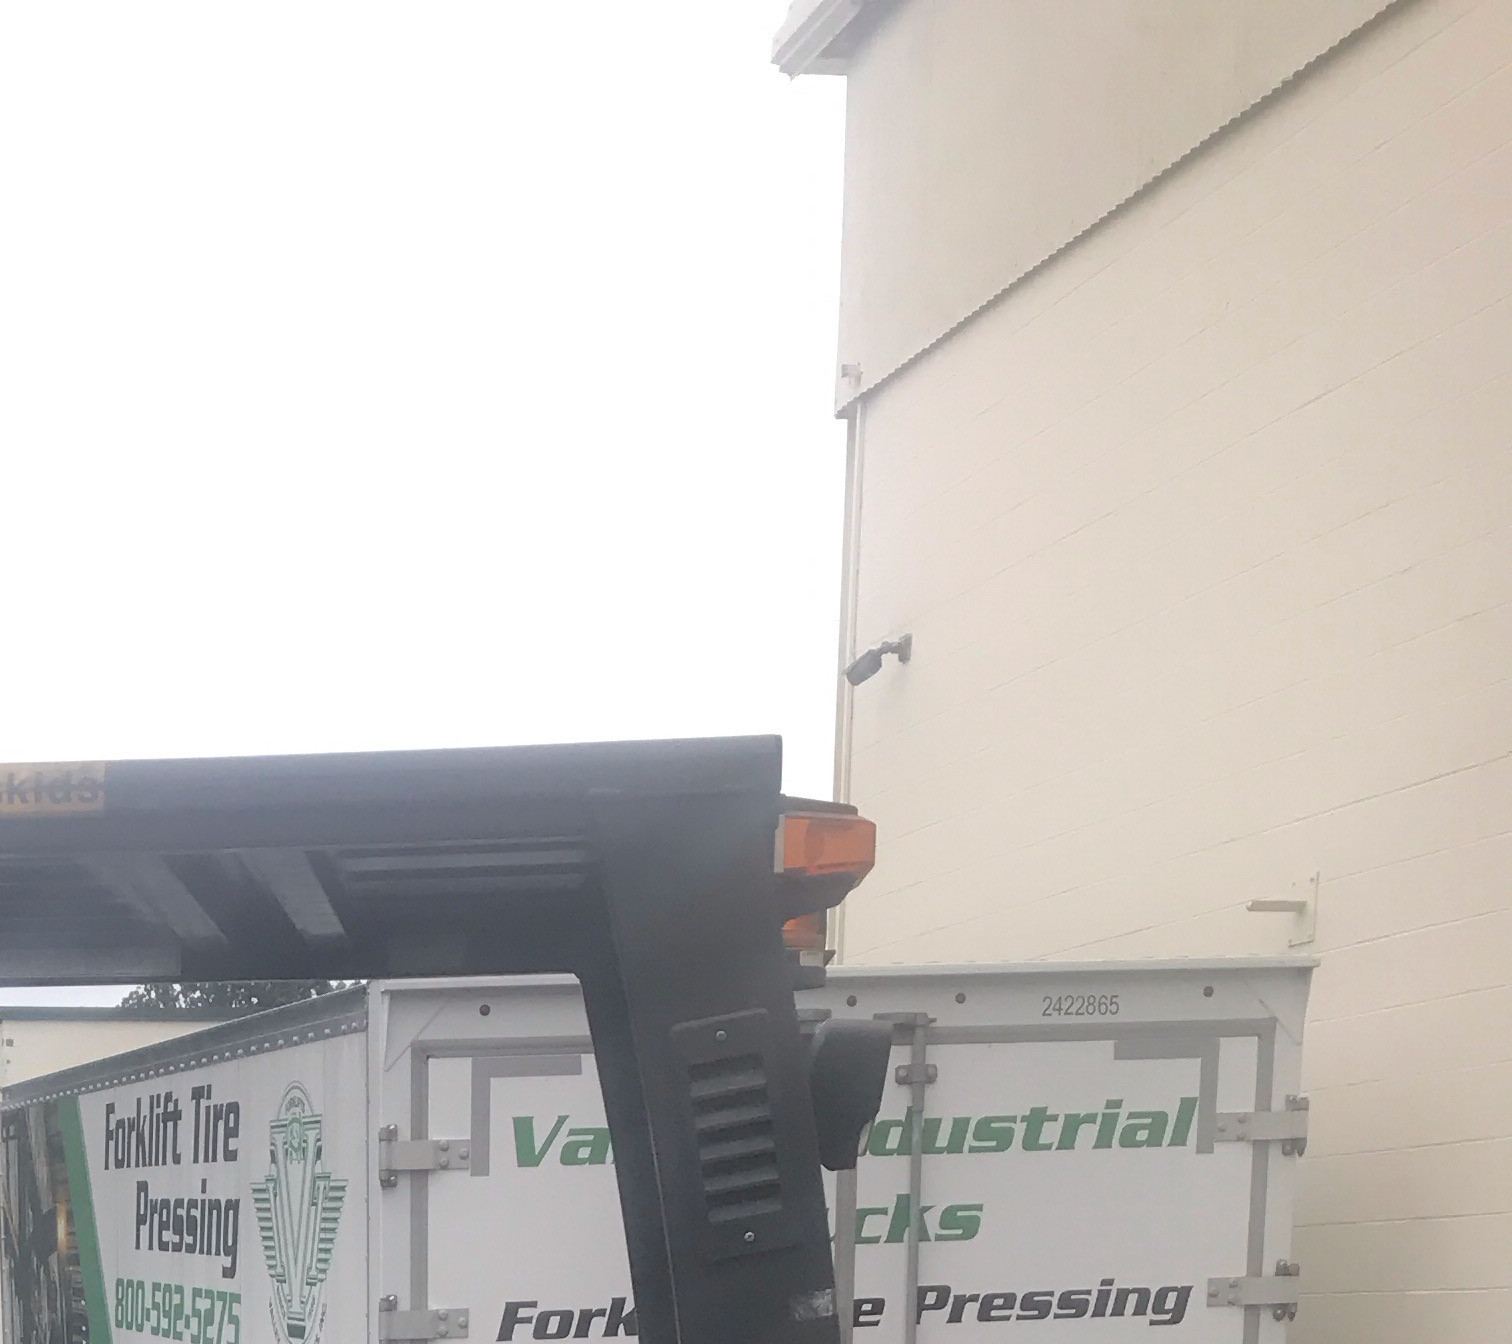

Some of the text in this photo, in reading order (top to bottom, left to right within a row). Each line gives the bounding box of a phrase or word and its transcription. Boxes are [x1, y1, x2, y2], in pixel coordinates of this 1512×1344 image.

[1042, 994, 1120, 1016] 2422865
[104, 1084, 240, 1171] Forklift Tire
[512, 1097, 1199, 1168] Va dustrial
[135, 1178, 240, 1279] Pressing
[854, 1193, 984, 1244] cks
[495, 1297, 639, 1341] Fork
[916, 1279, 1194, 1327] Pressing
